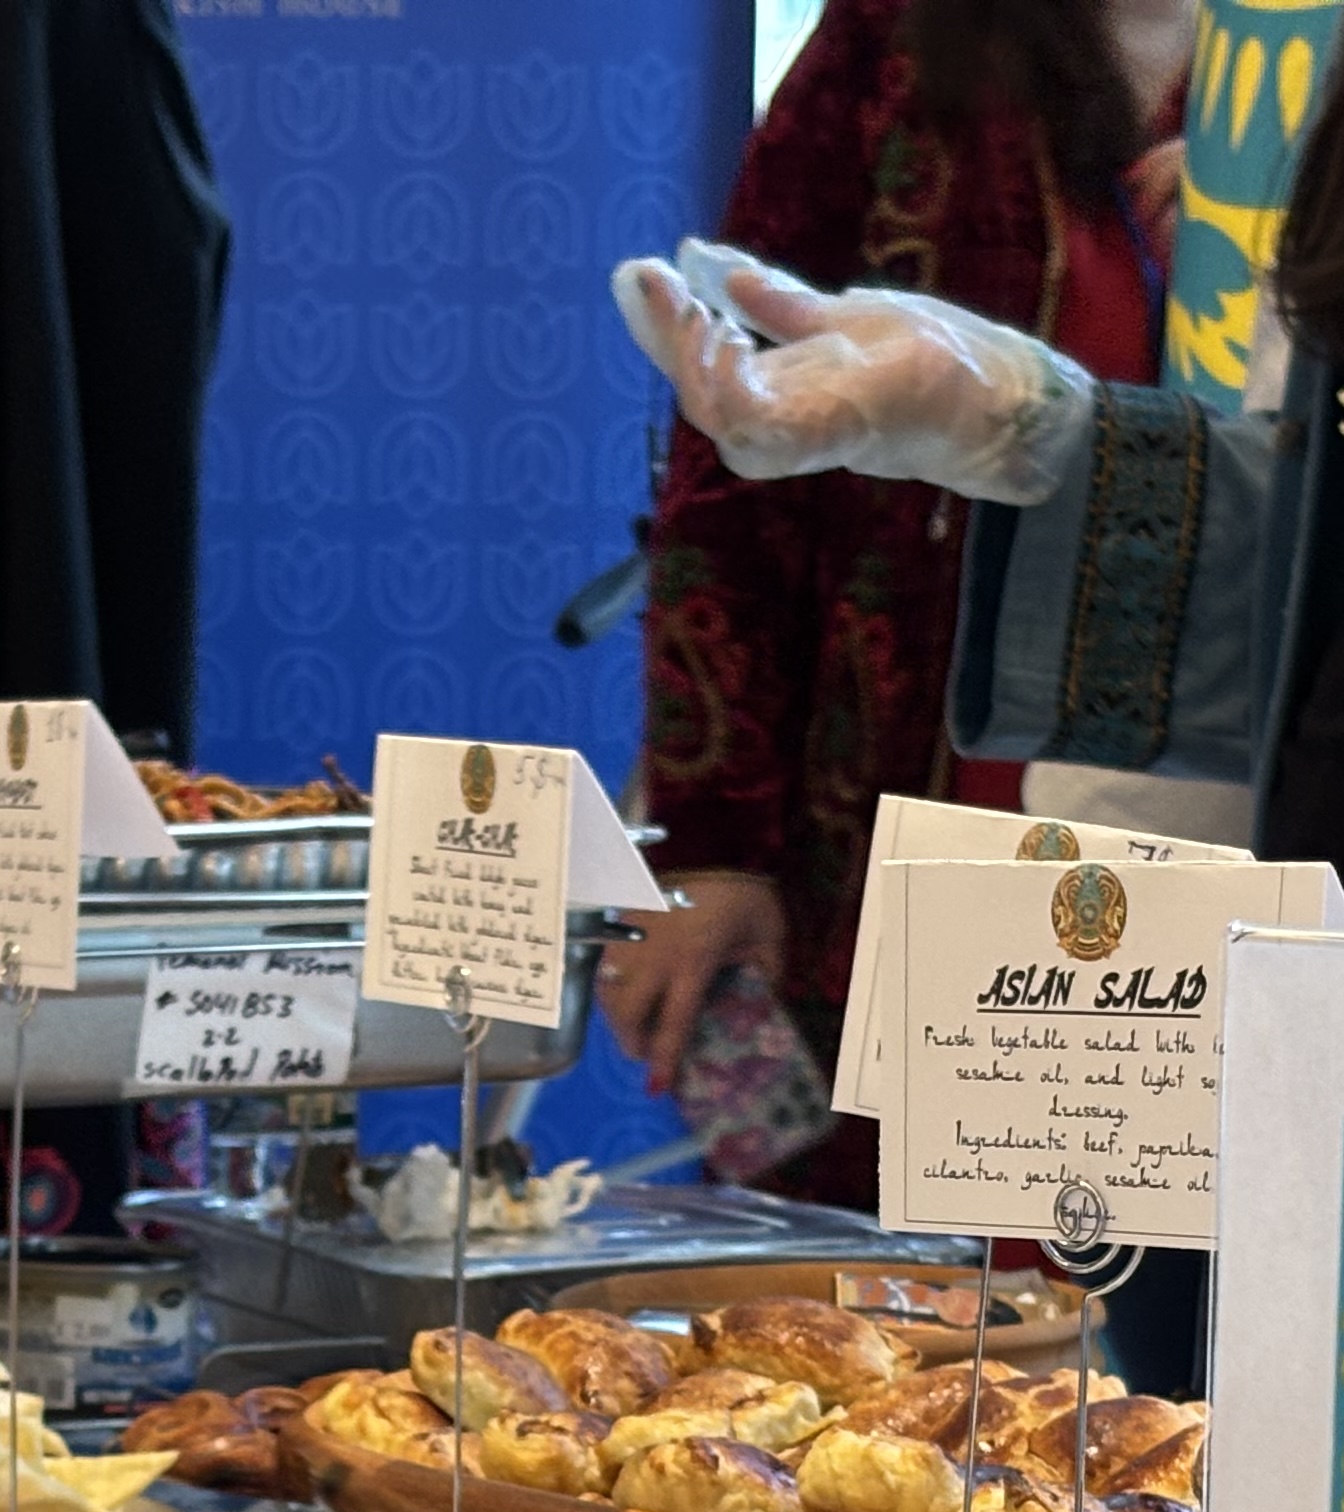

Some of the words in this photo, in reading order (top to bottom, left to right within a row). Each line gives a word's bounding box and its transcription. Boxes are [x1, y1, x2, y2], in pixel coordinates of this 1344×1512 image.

[976, 963, 1076, 1009] ASIAN
[1093, 963, 1208, 1012] SALAD
[923, 1024, 976, 1048] Fresh
[1083, 1028, 1141, 1053] salad
[1083, 1062, 1126, 1086] and
[1140, 1064, 1186, 1096] light
[1048, 1093, 1129, 1128] dressing.
[955, 1119, 1068, 1155] Ingredients:
